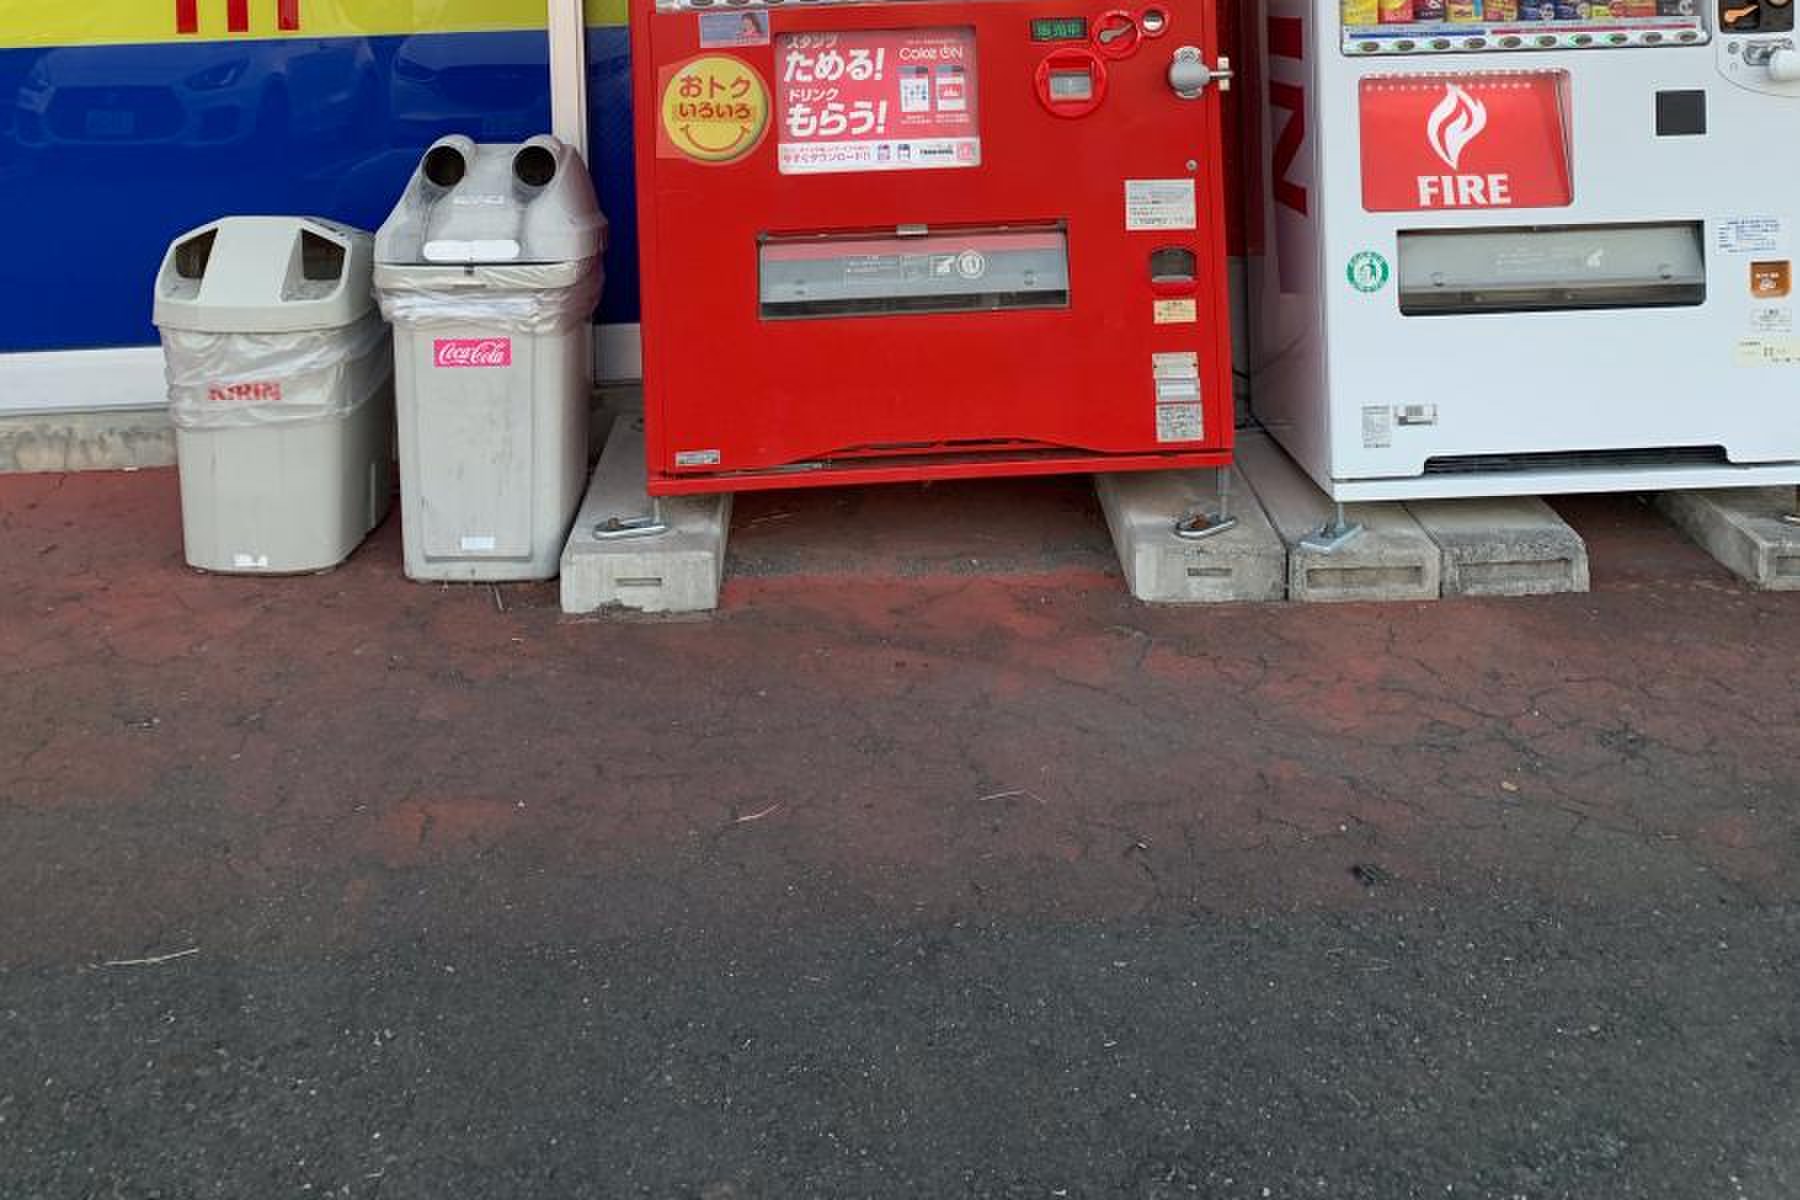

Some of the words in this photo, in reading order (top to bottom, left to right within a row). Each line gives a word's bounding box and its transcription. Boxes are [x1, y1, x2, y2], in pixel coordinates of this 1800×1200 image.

[784, 47, 885, 83] ためる!
[899, 47, 938, 61] Coke
[678, 74, 751, 99] おトク
[789, 87, 840, 102] ドリンク
[678, 101, 751, 120] いろいろ
[786, 100, 888, 137] もらう!
[1417, 173, 1512, 207] FIRE
